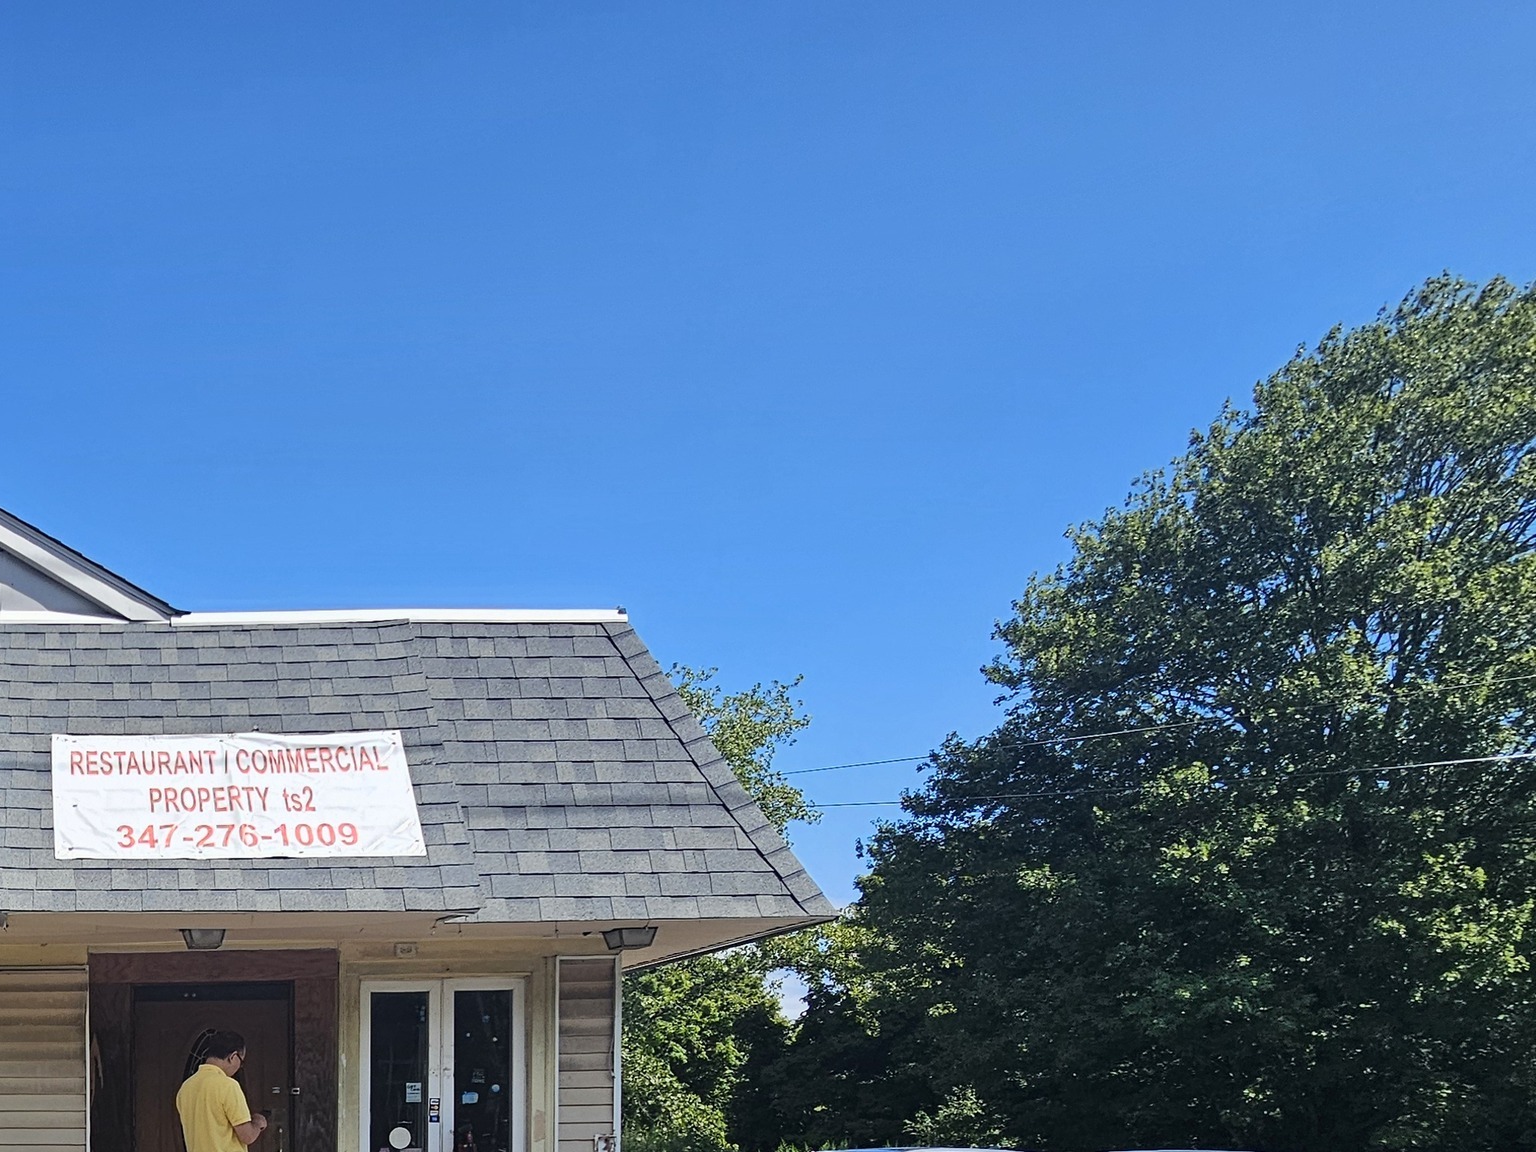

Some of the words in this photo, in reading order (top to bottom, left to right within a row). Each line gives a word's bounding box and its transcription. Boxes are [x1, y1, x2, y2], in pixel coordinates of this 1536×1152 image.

[70, 750, 216, 775] RESTAURANT
[235, 745, 389, 775] COMMERCIAL
[149, 785, 268, 812] PROPERTY
[282, 785, 316, 812] ts2
[116, 823, 359, 849] 347-276-1009
